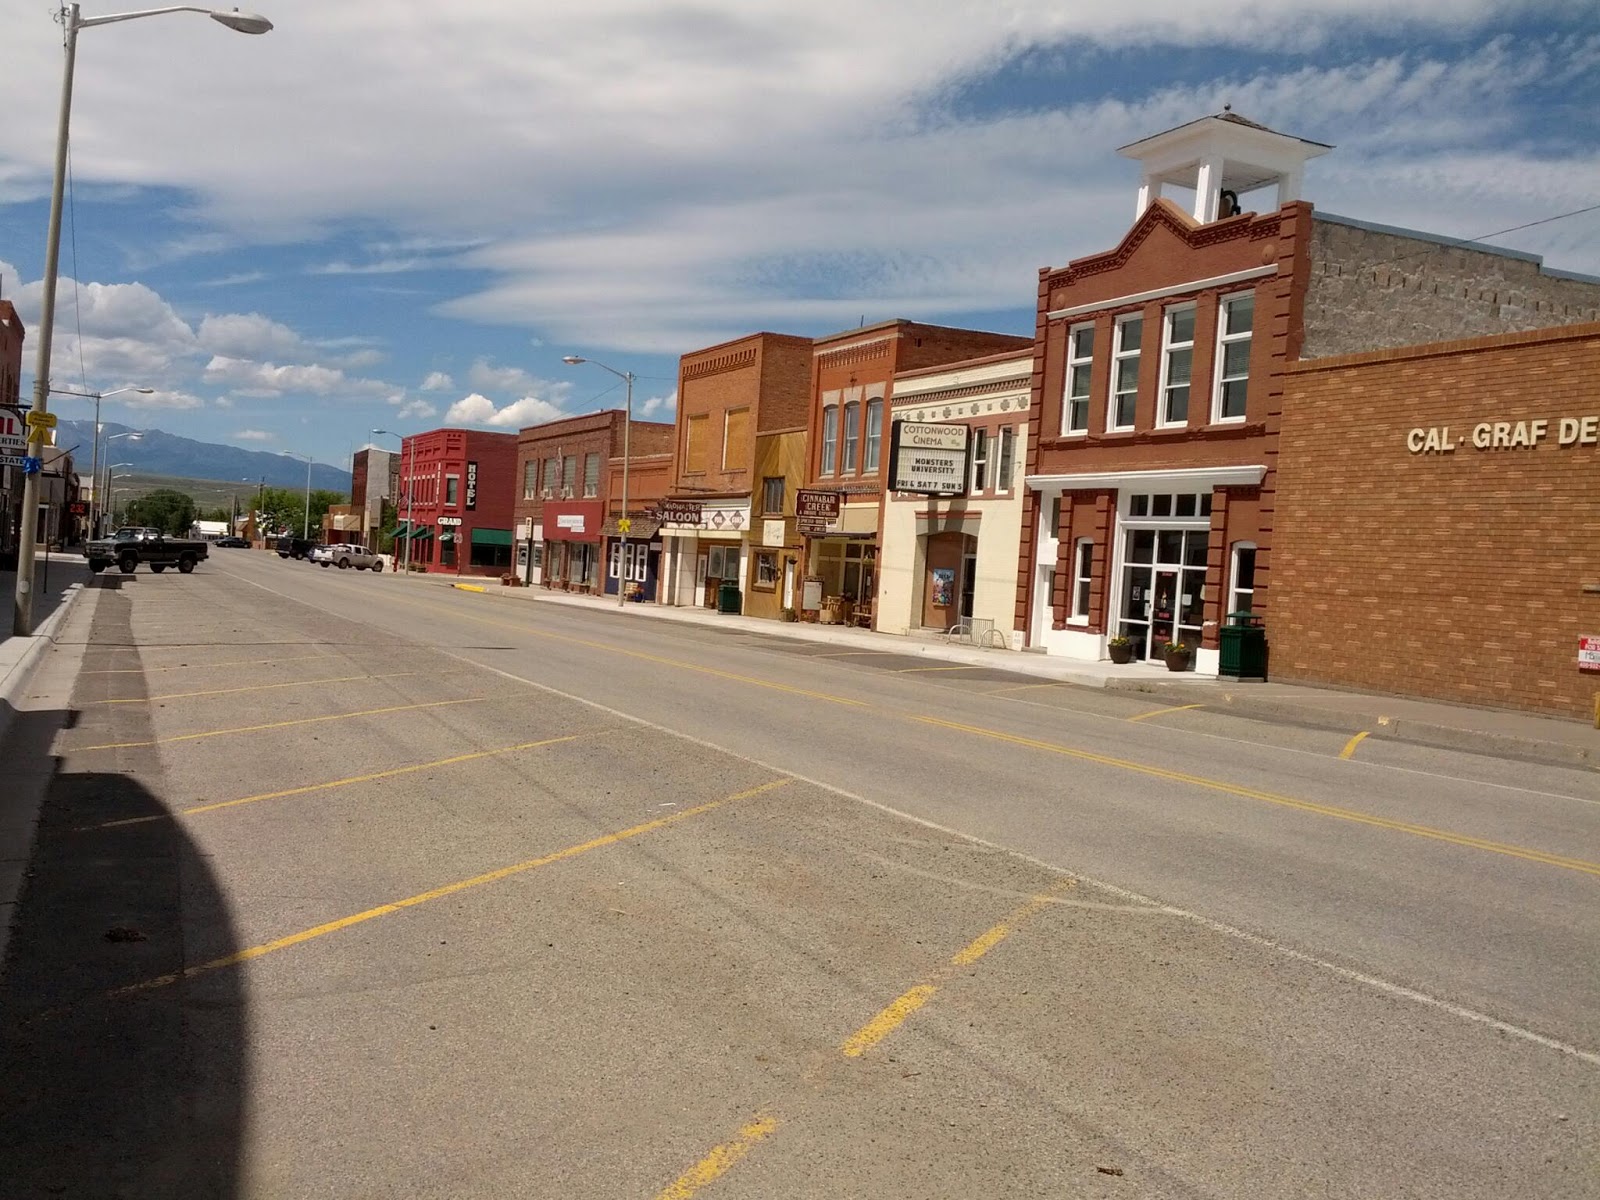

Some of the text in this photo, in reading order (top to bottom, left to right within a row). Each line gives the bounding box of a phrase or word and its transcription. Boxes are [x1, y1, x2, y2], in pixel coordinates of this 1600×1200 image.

[904, 425, 963, 436] COTTONWOOD
[1472, 420, 1548, 449] GRAF
[1559, 416, 1599, 445] DE
[913, 435, 943, 445] CINEMA
[915, 458, 953, 466] MONSTERS
[911, 466, 955, 474] UNIVERSITY
[466, 464, 476, 506] HOTEL
[917, 481, 932, 489] SAT
[802, 494, 834, 504] CINNABAR
[807, 502, 830, 510] CREEK
[656, 511, 698, 522] SALOON
